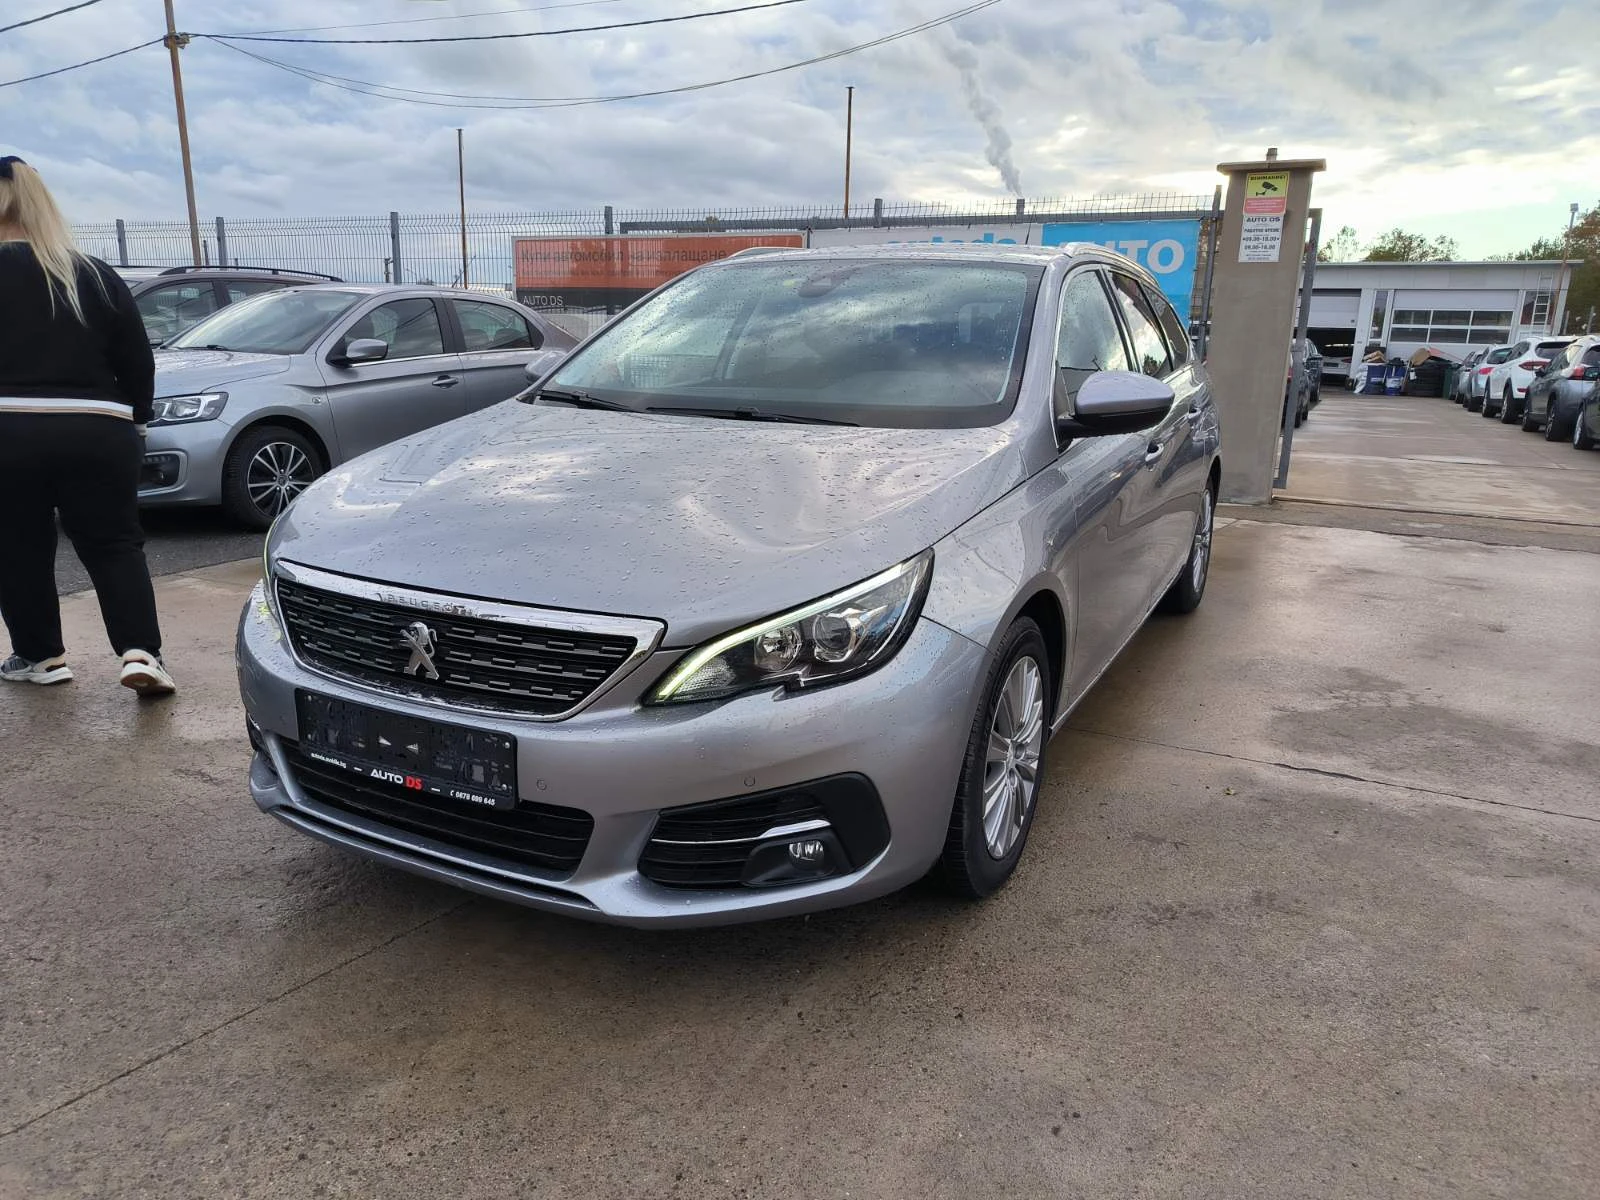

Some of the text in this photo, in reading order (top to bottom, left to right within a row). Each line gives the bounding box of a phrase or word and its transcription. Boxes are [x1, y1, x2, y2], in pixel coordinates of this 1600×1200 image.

[523, 295, 564, 306] AUTO DS
[370, 768, 423, 790] AUTO DS
